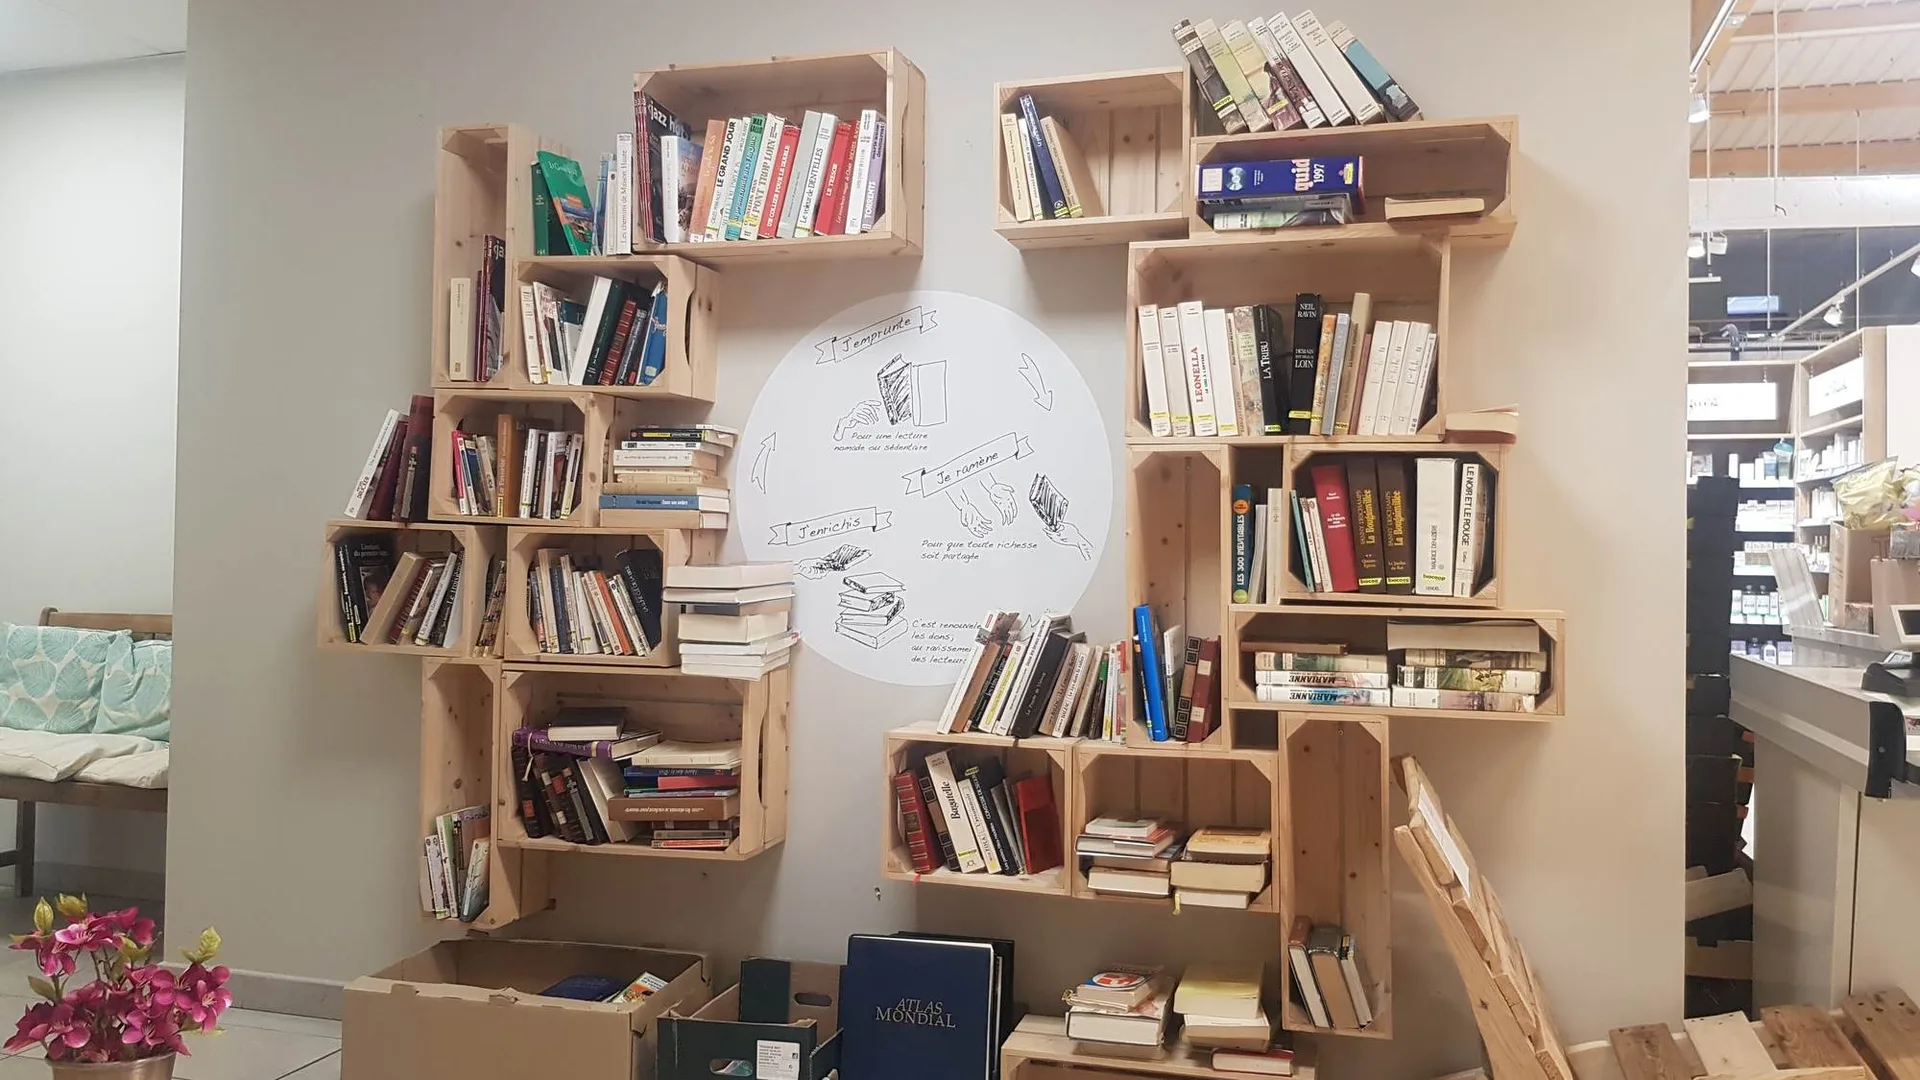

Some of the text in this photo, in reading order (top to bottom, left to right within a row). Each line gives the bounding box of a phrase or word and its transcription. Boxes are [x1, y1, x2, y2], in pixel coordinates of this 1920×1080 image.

[648, 100, 668, 127] jazz
[716, 122, 736, 188] LE GRAND JOUR
[808, 148, 824, 186] DENTELLES
[1292, 158, 1314, 191] quid
[1314, 164, 1325, 183] 1997
[753, 139, 776, 212] PONT TROP LOIN
[864, 182, 876, 218] TORRENTS
[842, 317, 911, 352] J'emprunte
[1294, 360, 1314, 368] LOIN
[1191, 346, 1204, 403] LEONELLA
[1262, 366, 1272, 380] LA
[896, 431, 928, 440] lecture
[937, 452, 998, 484] Je ramène
[1466, 466, 1474, 476] LE
[1465, 476, 1474, 496] NOIR
[1464, 496, 1472, 506] ET
[1464, 506, 1472, 517] LE
[798, 517, 860, 539] J'enrichis
[1462, 518, 1470, 546] ROUGE
[922, 540, 1038, 552] Pour que toute richesse
[1366, 535, 1376, 544] La
[1394, 537, 1404, 546] La
[920, 552, 940, 560] soit
[1236, 557, 1244, 573] 300
[1236, 574, 1244, 586] LES
[912, 619, 937, 629] C'est
[912, 632, 926, 640] les
[1288, 675, 1336, 684] MARIANNE
[1290, 692, 1338, 701] MARIANNE
[942, 781, 960, 820] Bagatelle
[896, 998, 943, 1014] ATLAS
[876, 1006, 956, 1028] MONDIAL
